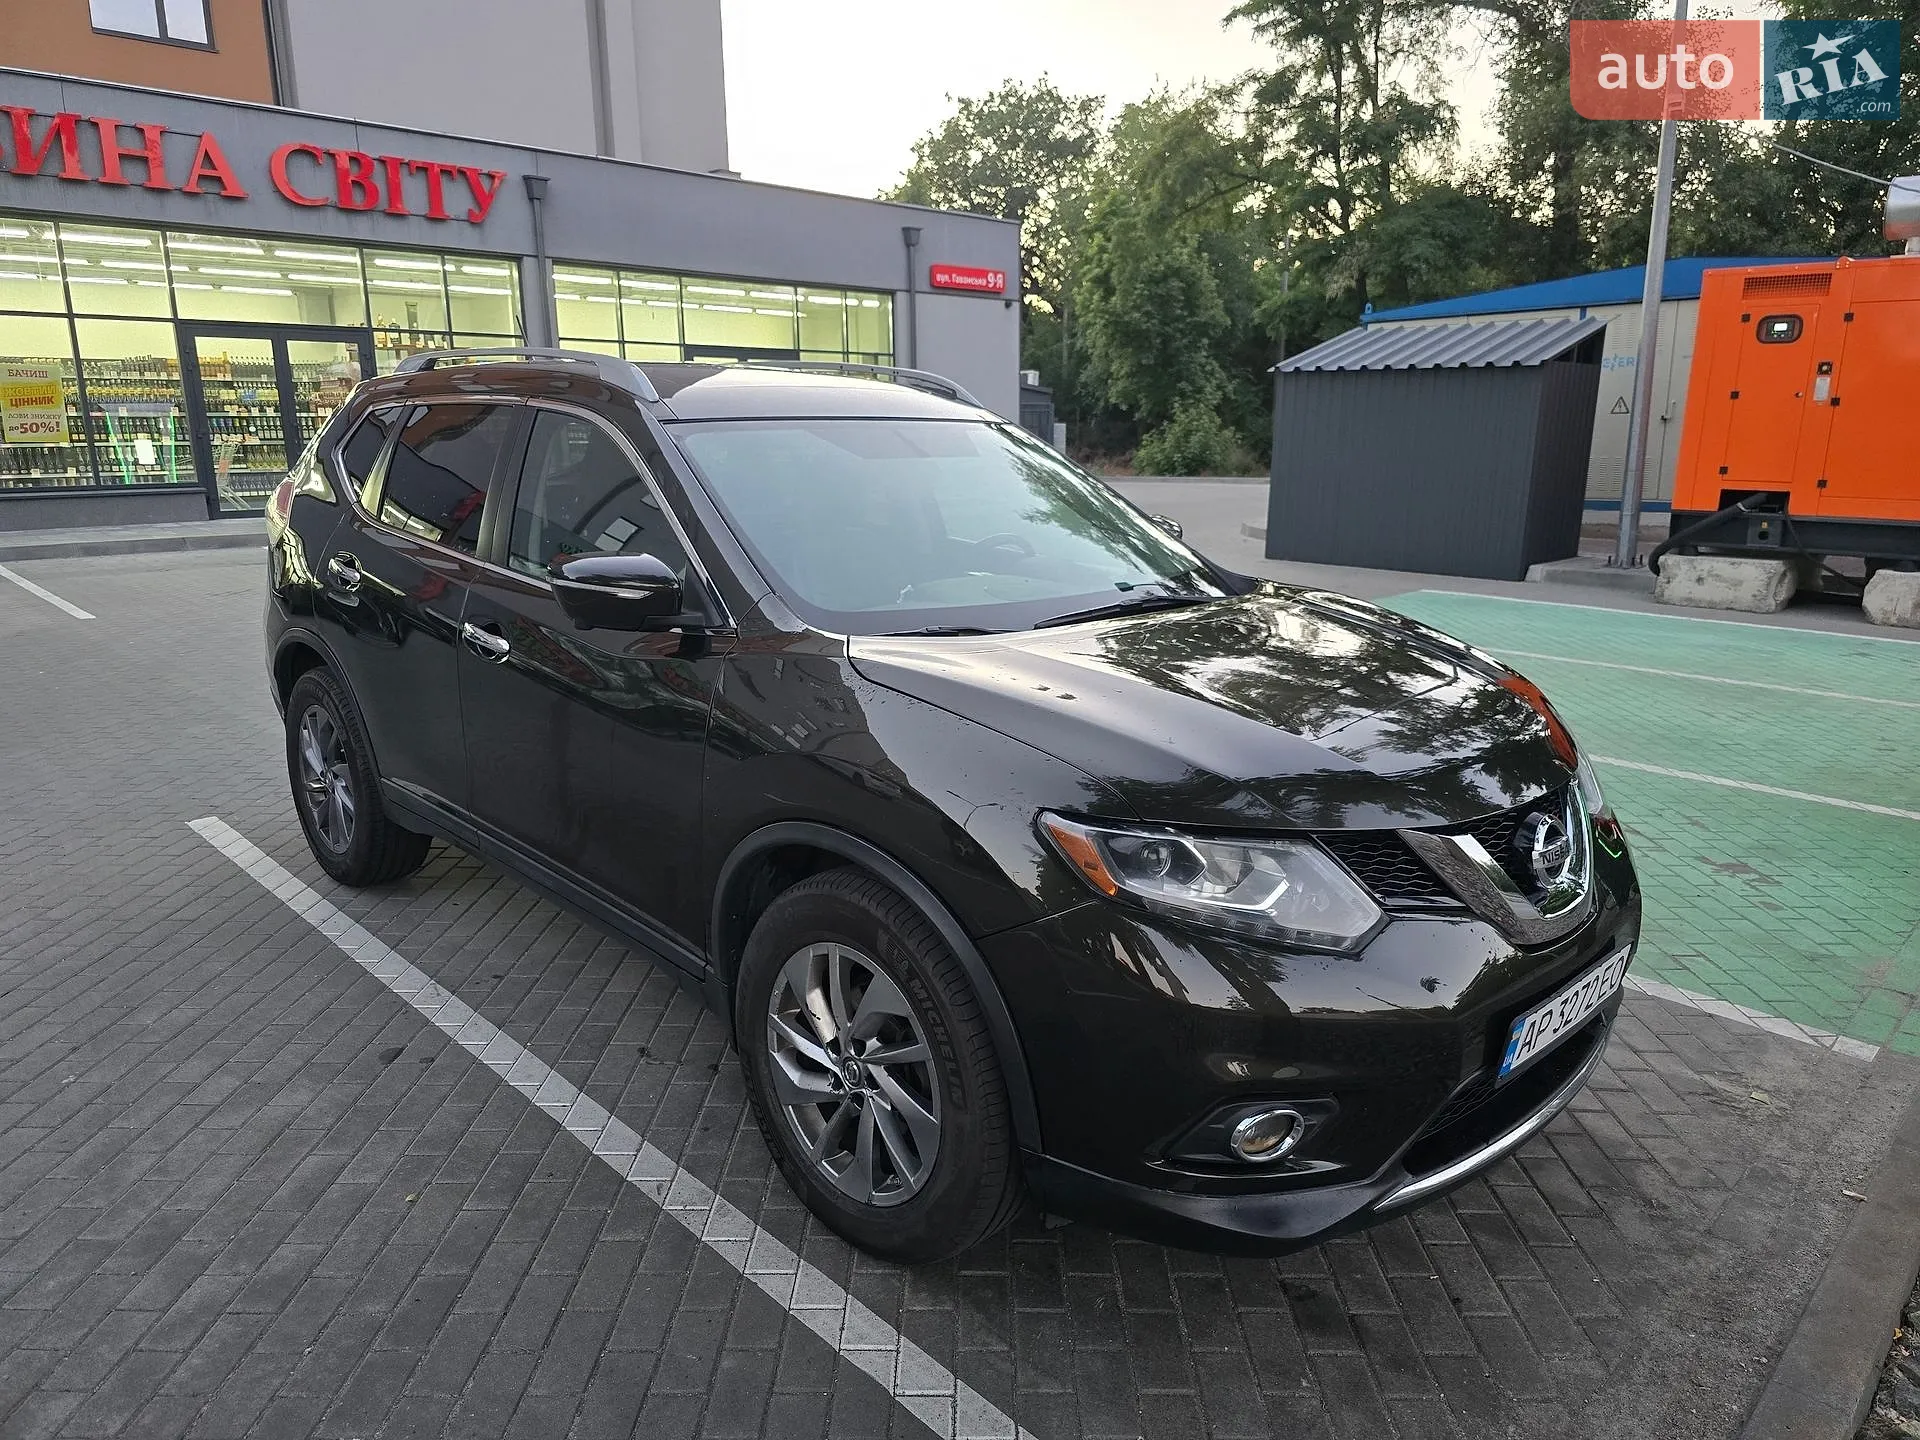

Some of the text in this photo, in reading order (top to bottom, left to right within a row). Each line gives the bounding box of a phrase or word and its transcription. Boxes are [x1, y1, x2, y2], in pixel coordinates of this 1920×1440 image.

[0, 104, 508, 225] ИНА СВІТУ
[7, 369, 49, 378] БАЧИШ
[9, 395, 56, 408] ЦІННИК
